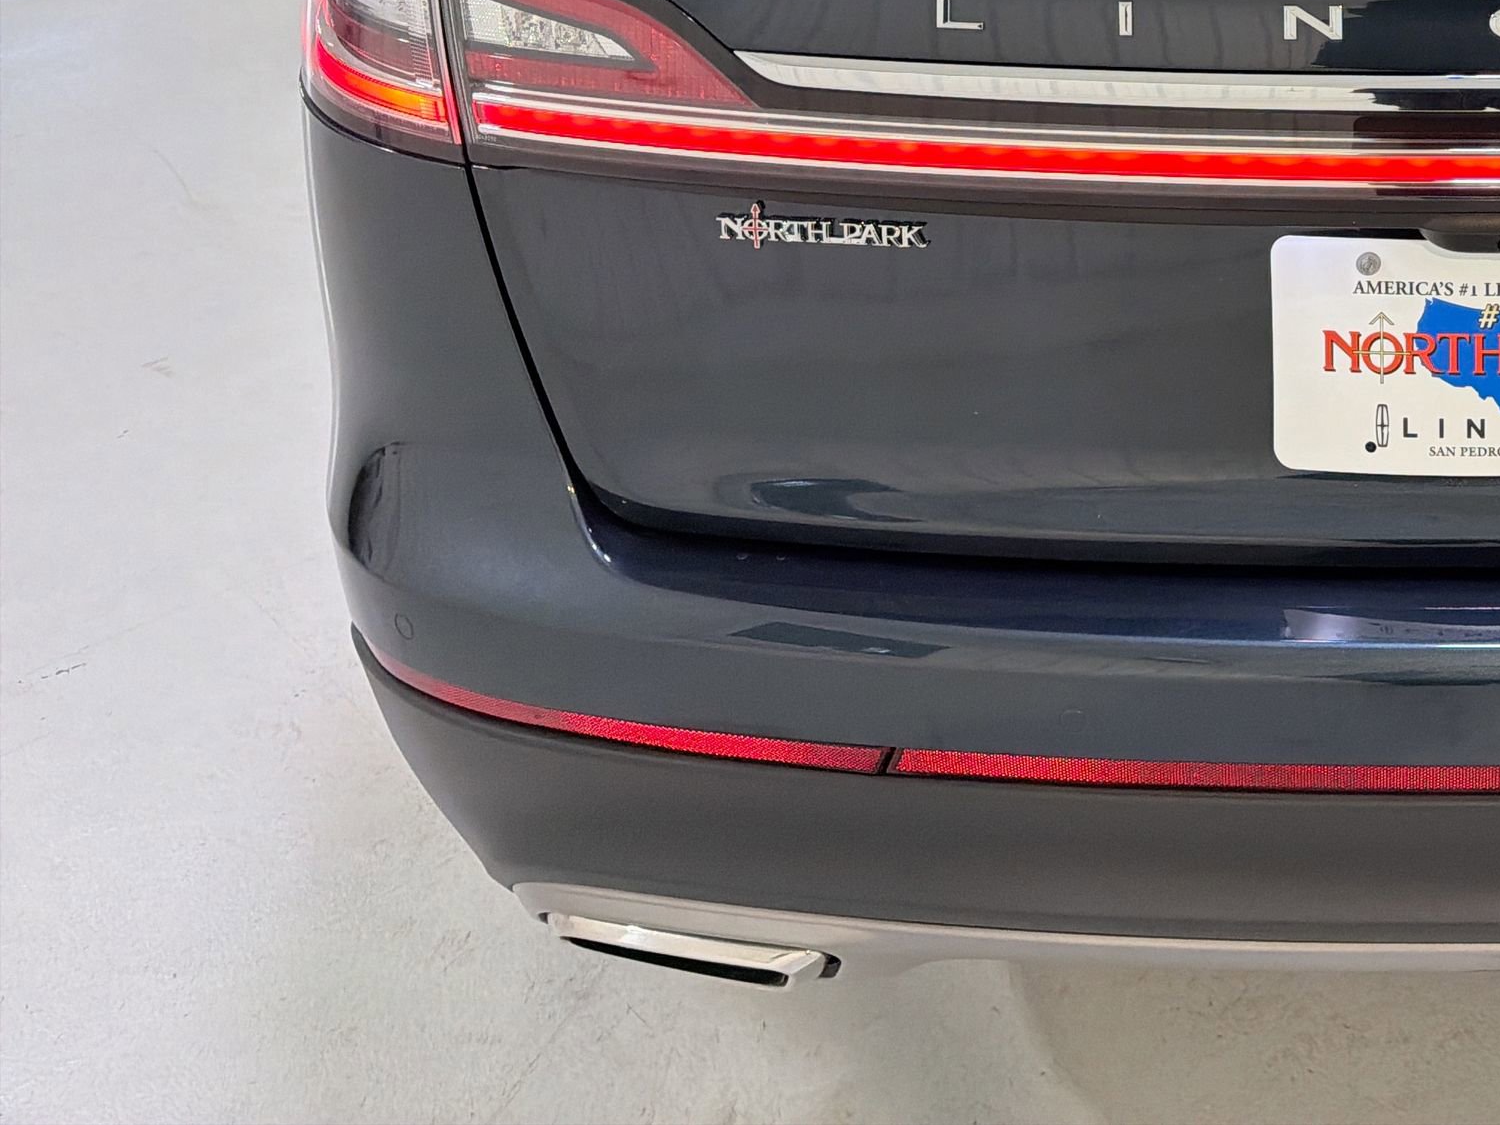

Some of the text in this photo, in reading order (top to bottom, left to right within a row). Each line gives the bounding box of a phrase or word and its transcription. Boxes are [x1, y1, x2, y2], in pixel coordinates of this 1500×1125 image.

[715, 214, 931, 249] NORTH PARK
[1352, 280, 1455, 297] AMERICA'S
[1458, 283, 1478, 297] #1
[1429, 446, 1456, 458] SAN
